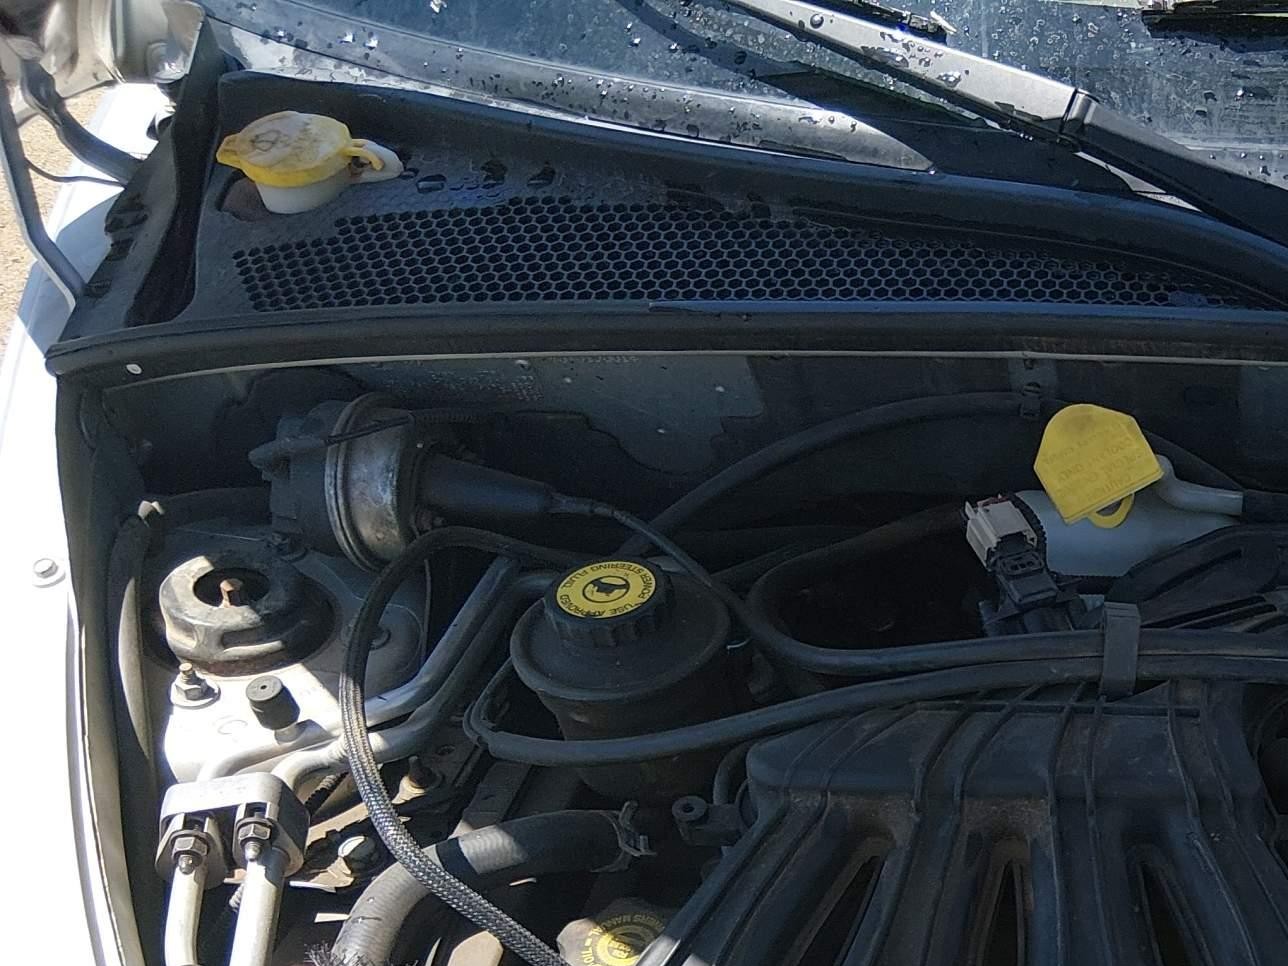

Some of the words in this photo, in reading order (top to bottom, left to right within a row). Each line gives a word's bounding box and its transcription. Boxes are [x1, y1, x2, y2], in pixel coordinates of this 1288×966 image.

[590, 562, 644, 575] STEERING
[559, 594, 606, 617] APPROVED
[609, 603, 634, 615] USE
